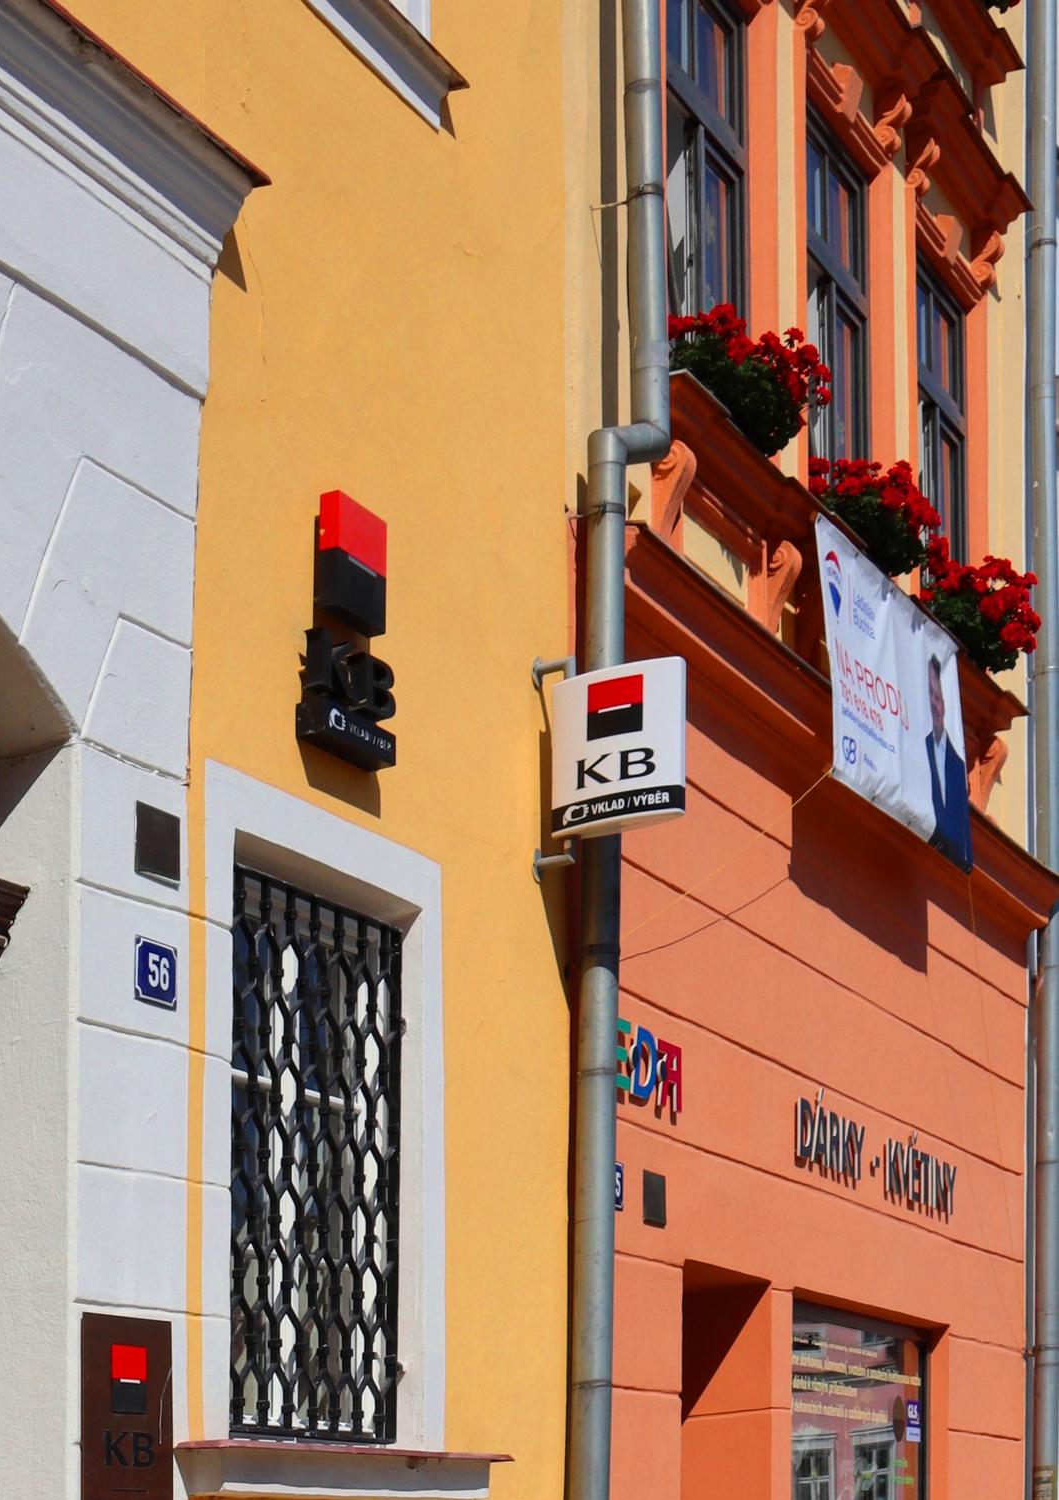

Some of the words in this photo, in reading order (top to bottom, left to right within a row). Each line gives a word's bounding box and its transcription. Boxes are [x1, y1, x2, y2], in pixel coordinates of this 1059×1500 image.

[575, 747, 656, 791] KB
[591, 798, 625, 815] VKLAD
[633, 791, 670, 807] VÝBĚR
[147, 952, 170, 991] 56
[796, 1088, 865, 1180] DÁRKY
[885, 1131, 957, 1216] KVĚTINY
[103, 1430, 155, 1468] KB
